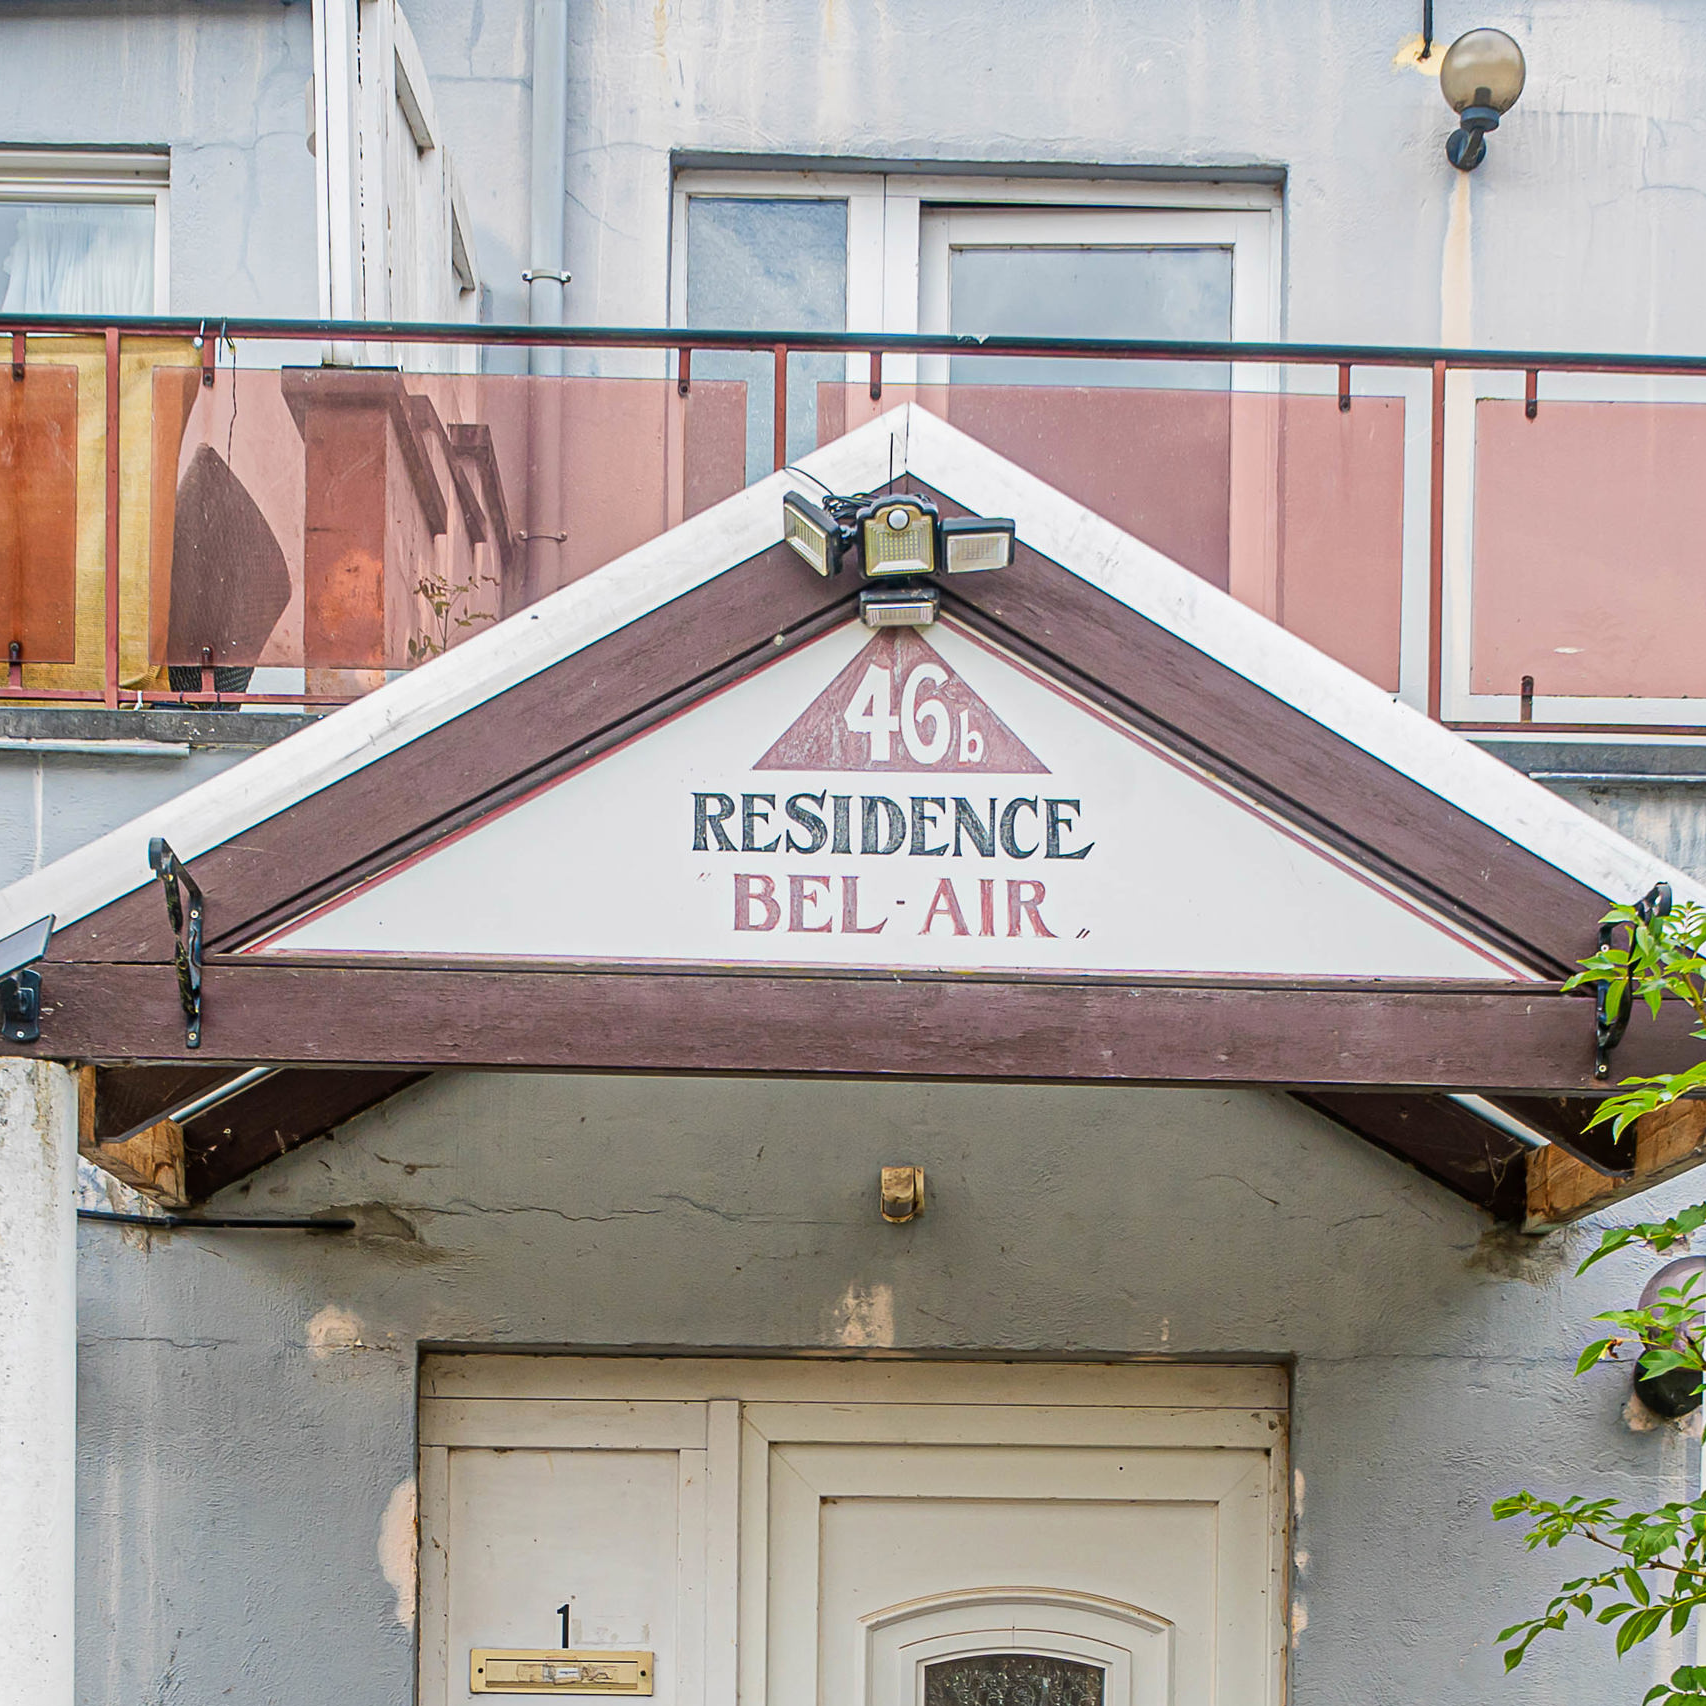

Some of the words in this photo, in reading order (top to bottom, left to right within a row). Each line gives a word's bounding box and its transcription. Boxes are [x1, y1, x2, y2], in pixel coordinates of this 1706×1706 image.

[843, 663, 985, 765] 46b
[690, 788, 1096, 860] RESIDENCE
[556, 1603, 570, 1649] 1
